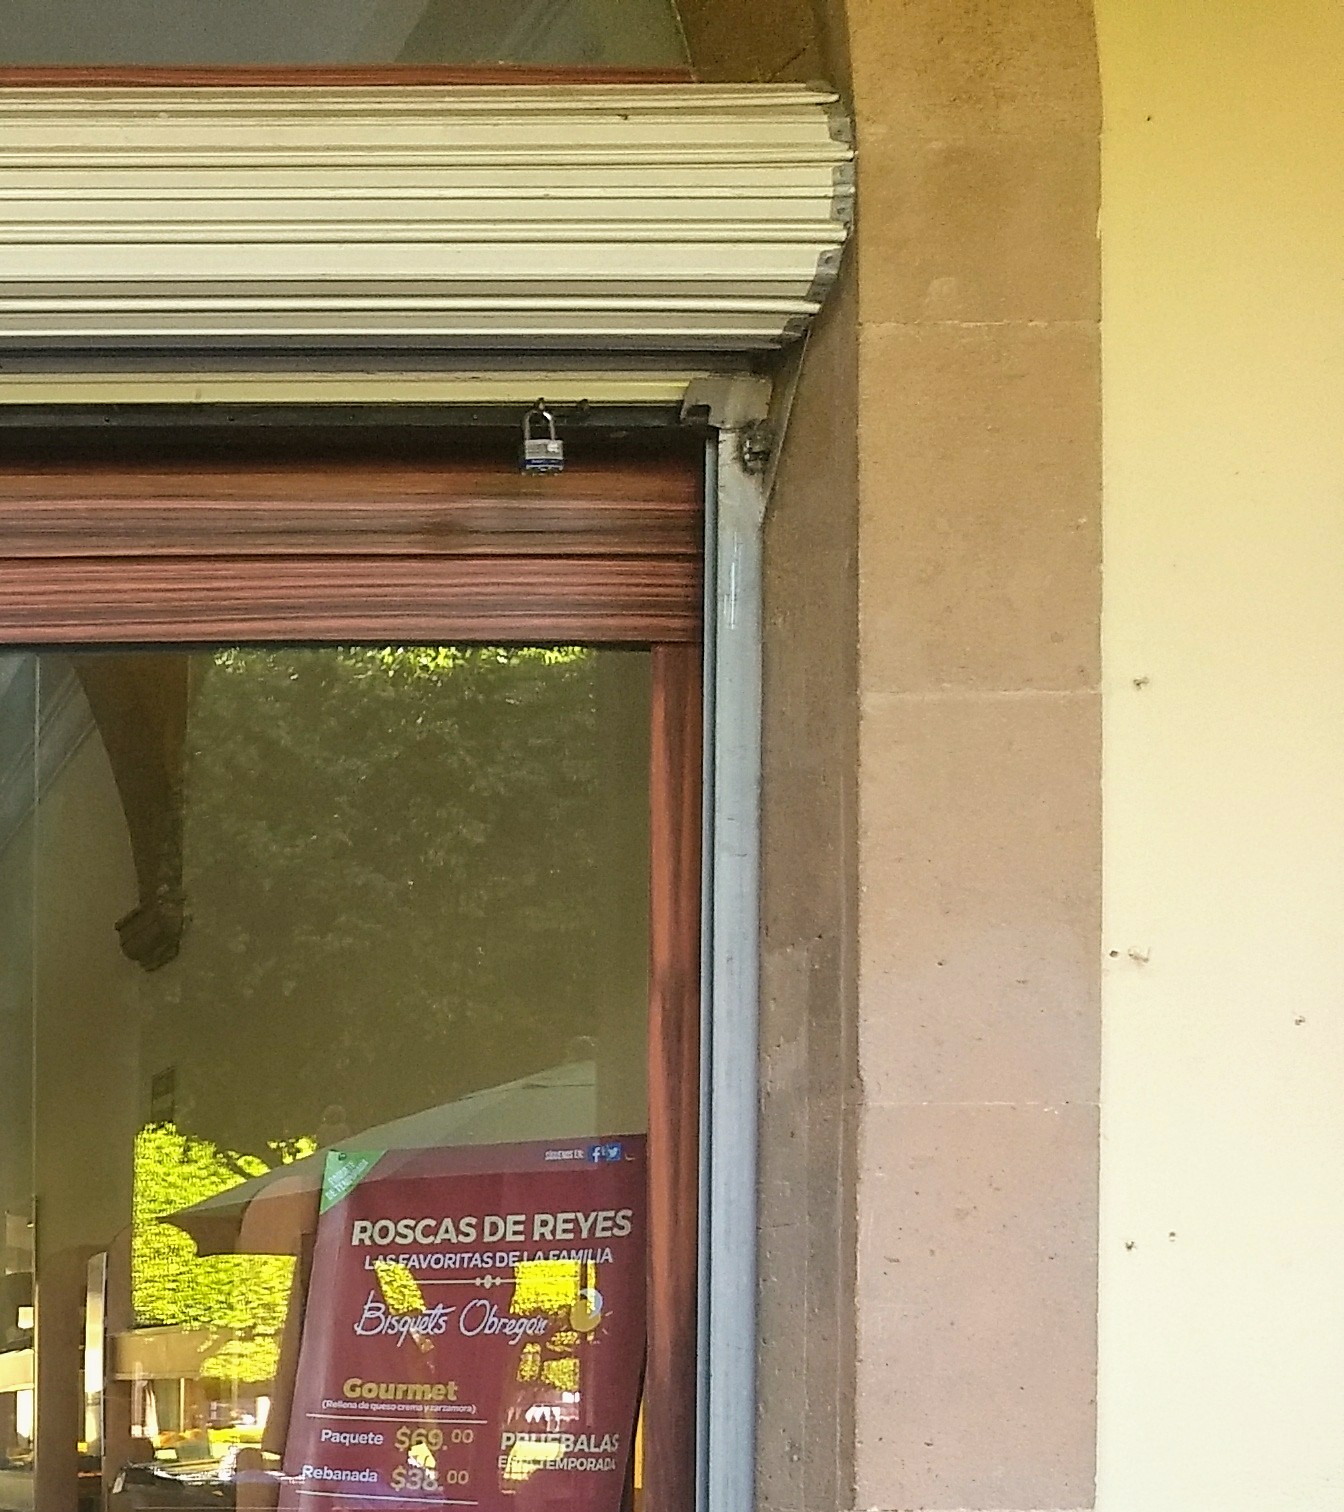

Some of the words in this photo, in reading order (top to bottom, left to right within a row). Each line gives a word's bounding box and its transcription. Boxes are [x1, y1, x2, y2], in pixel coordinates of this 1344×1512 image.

[352, 1216, 477, 1246] ROSCAS
[483, 1214, 525, 1242] DE
[532, 1208, 633, 1241] REYES
[398, 1252, 493, 1269] FAVORITAS
[495, 1251, 520, 1268] DE
[549, 1247, 613, 1265] FAMILIA
[354, 1289, 456, 1348] Bisquets
[343, 1377, 458, 1401] Gourmet
[321, 1429, 383, 1446] Paquete
[302, 1465, 378, 1482] Rebanada
